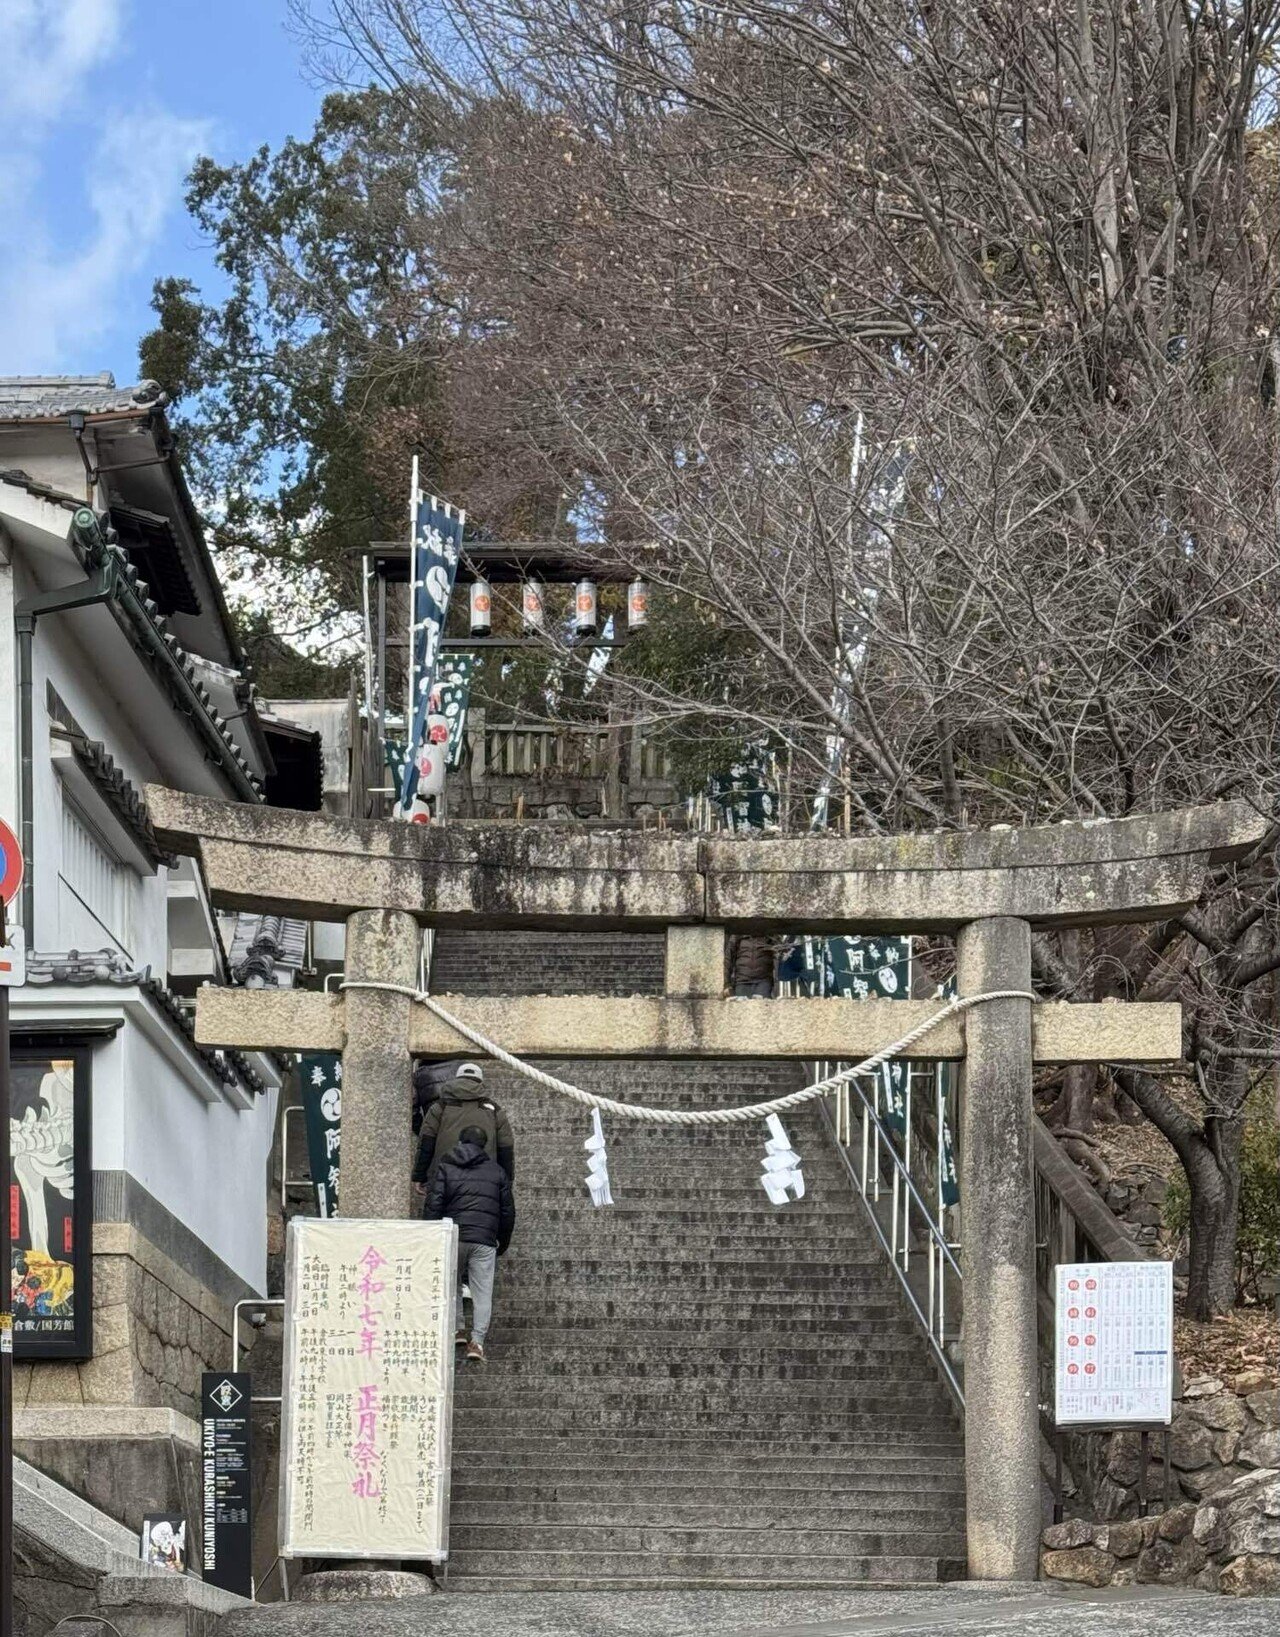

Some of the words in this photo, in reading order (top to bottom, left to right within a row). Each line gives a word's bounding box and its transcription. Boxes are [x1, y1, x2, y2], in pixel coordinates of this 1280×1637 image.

[356, 1244, 389, 1361] 令和七年
[404, 1258, 413, 1293] 一月一日
[203, 1418, 216, 1457] UKIYO-E
[351, 1384, 384, 1499] 正月祭礼
